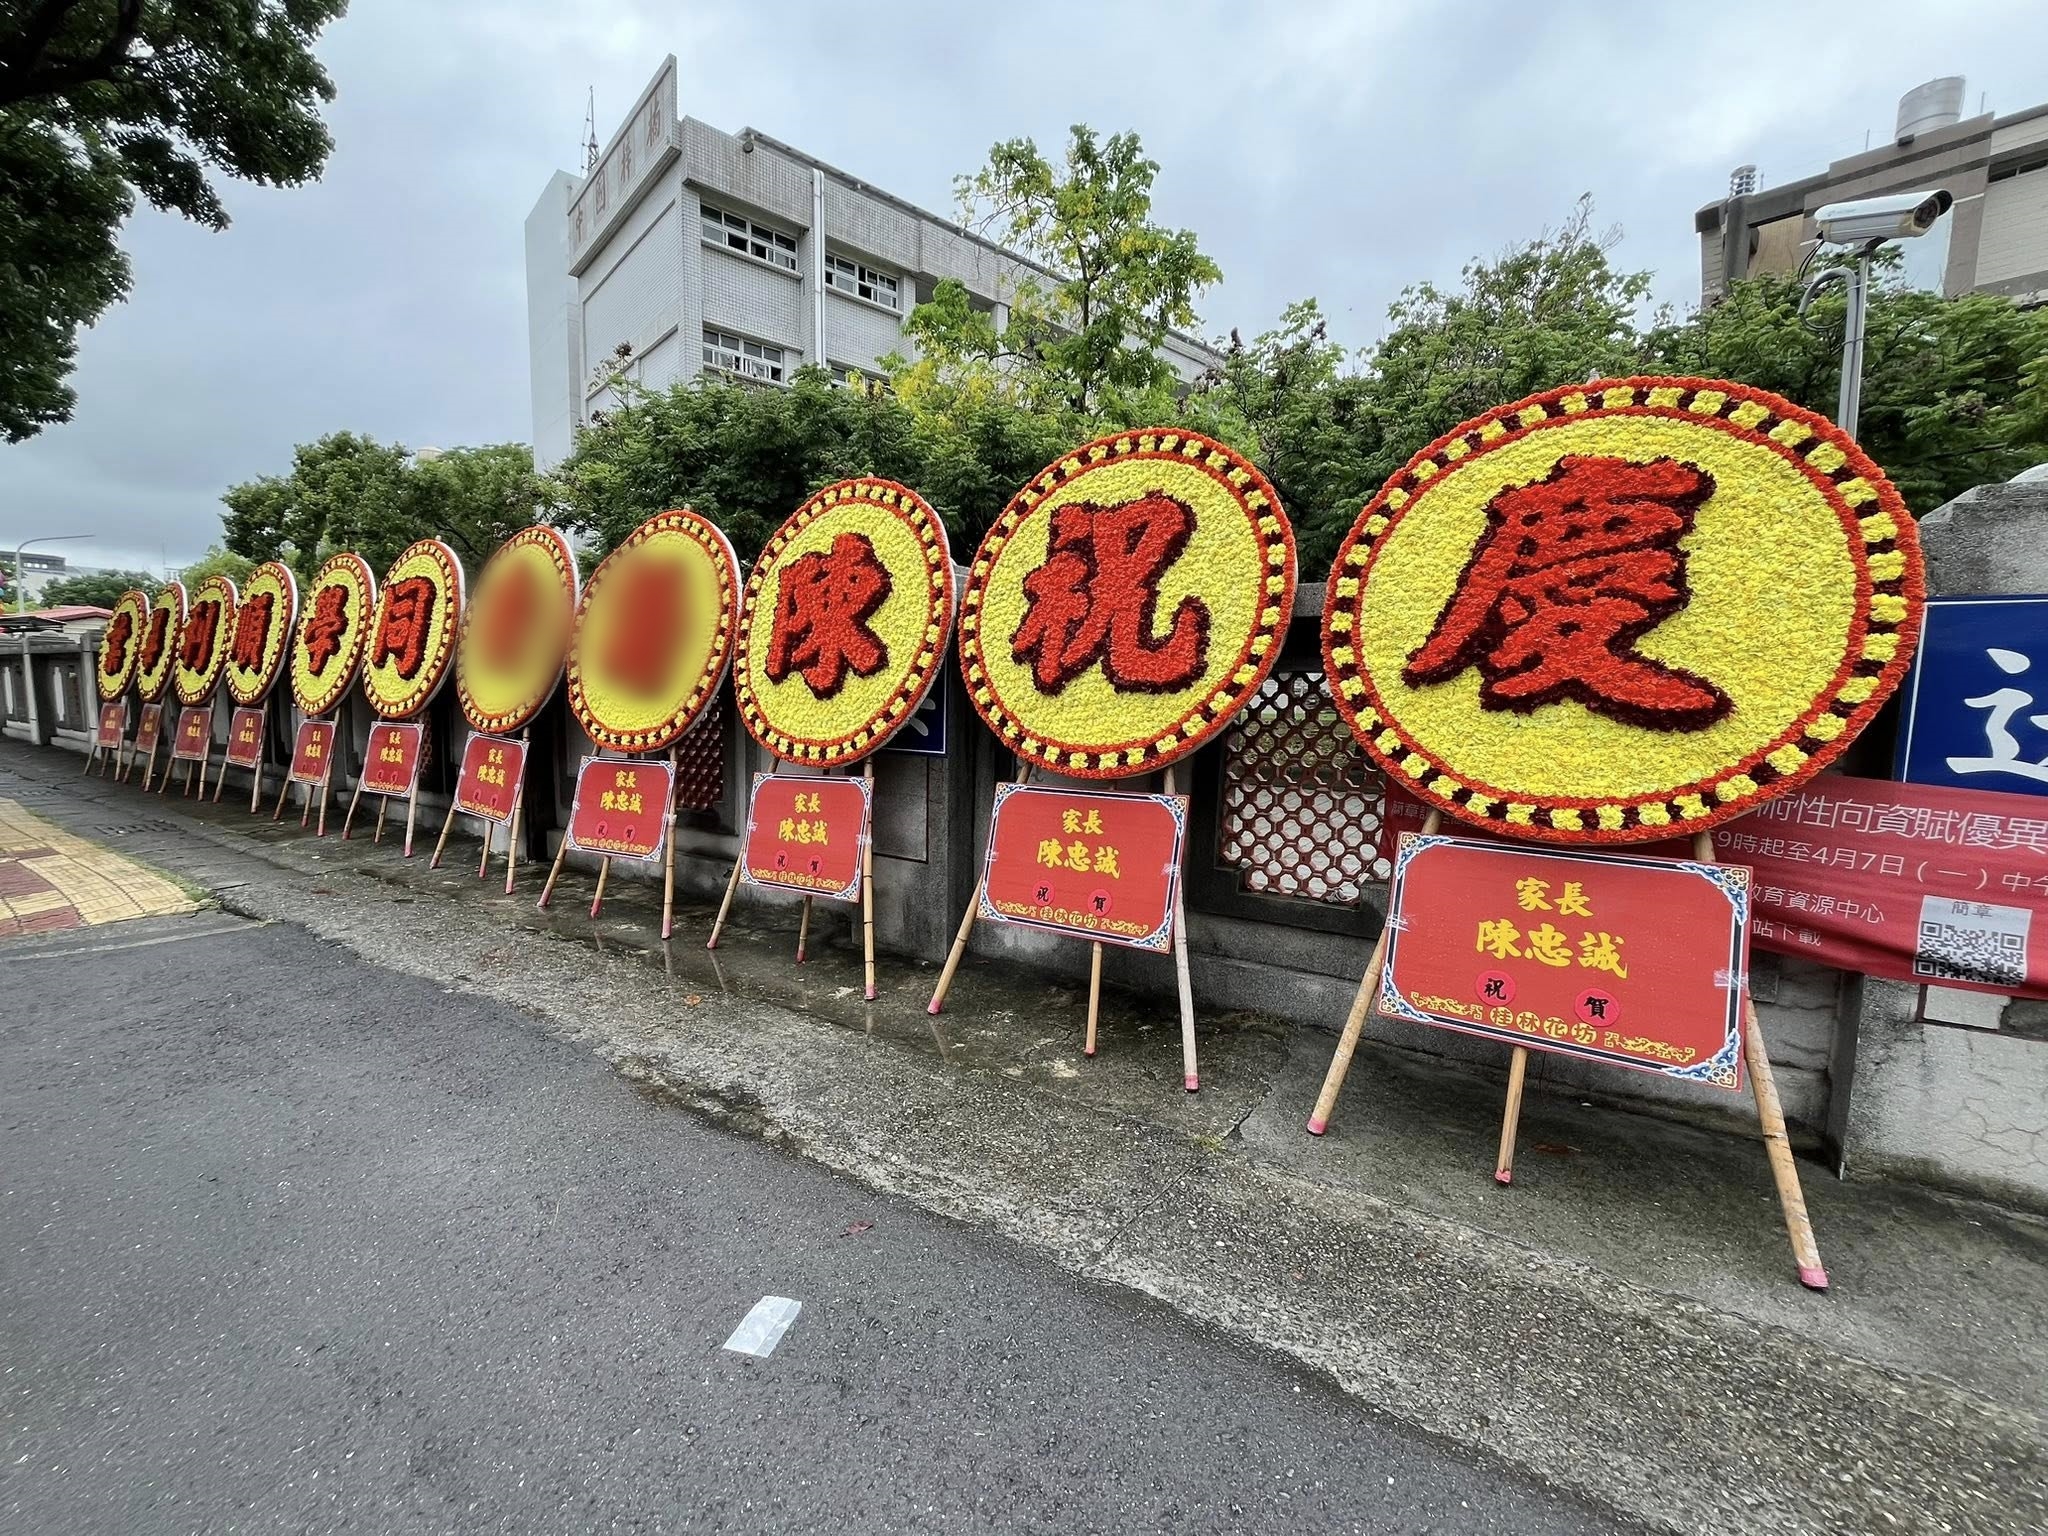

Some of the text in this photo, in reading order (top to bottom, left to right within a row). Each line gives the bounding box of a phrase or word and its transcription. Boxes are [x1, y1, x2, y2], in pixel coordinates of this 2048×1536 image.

[1011, 490, 1212, 695] 祝
[1402, 455, 1735, 733] 慶
[372, 575, 436, 681] 同
[764, 533, 892, 699] 陳
[1946, 648, 2048, 783] 立
[794, 792, 821, 814] 家長
[1061, 808, 1105, 835] 家長
[778, 817, 829, 846] 陳忠誠
[1036, 837, 1121, 880] 陳忠誠
[1035, 885, 1107, 913] 祝 賀
[1515, 876, 1594, 917] 家長
[1951, 901, 1993, 919] 簡章
[1475, 919, 1628, 979] 陳忠誠
[1483, 977, 1609, 1021] 祝 賀
[1489, 1006, 1597, 1044] 桂林花坊
